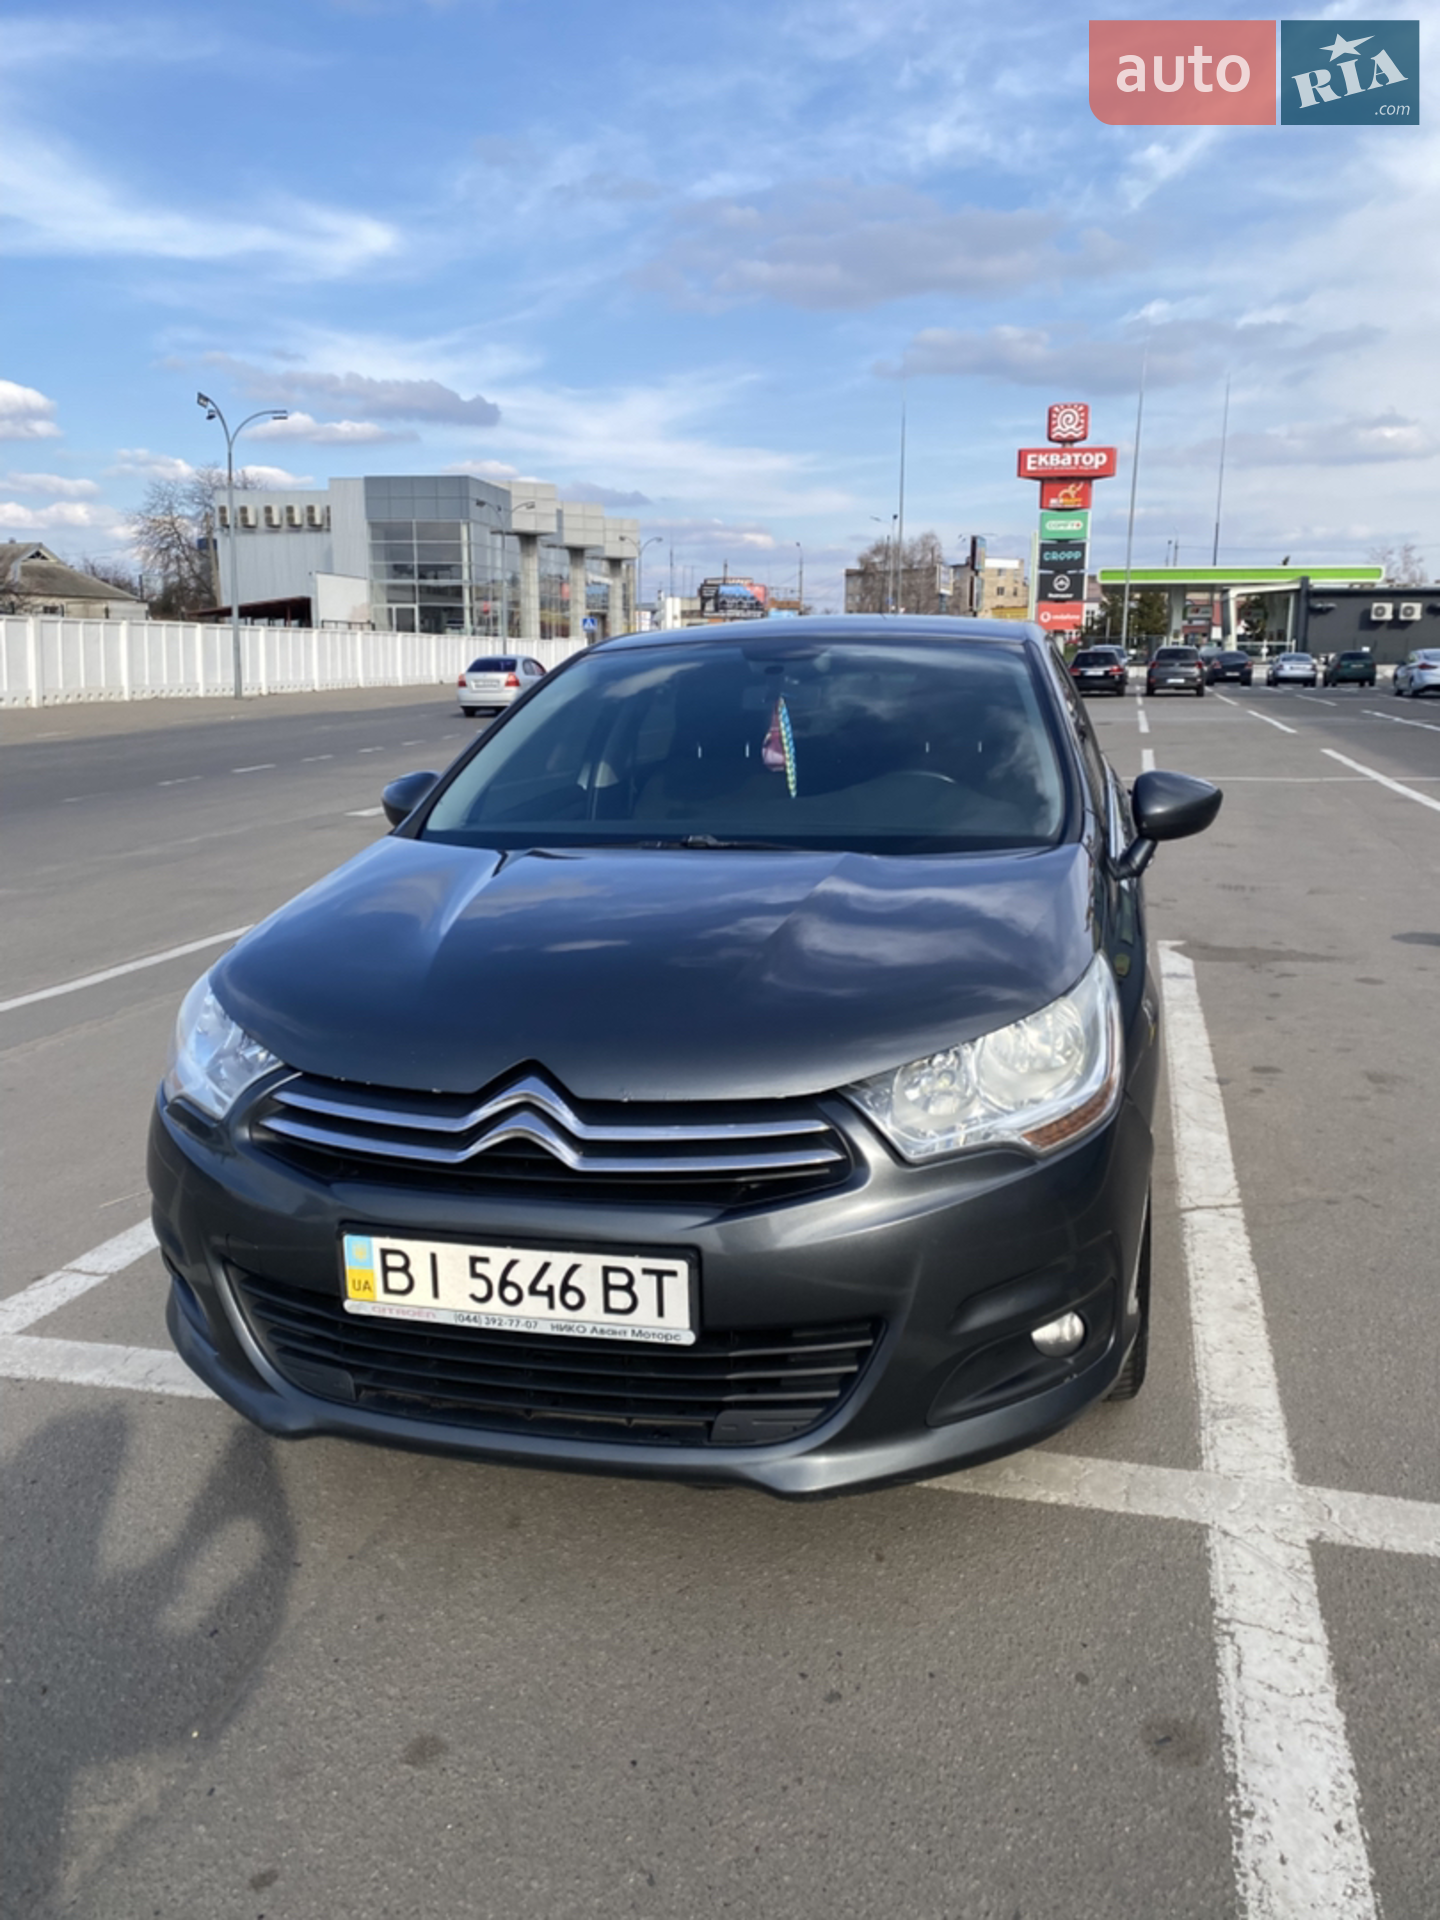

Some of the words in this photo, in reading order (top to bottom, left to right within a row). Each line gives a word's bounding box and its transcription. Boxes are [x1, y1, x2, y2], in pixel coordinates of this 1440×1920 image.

[1043, 551, 1082, 562] CROPP
[352, 1278, 373, 1293] UA
[468, 1255, 586, 1311] 5646
[602, 1265, 678, 1318] BT
[454, 1313, 482, 1326] (044)
[484, 1317, 538, 1329] 392-77-07
[550, 1322, 587, 1334] НИКО
[590, 1326, 628, 1337] Авант
[631, 1329, 682, 1342] Моторс
